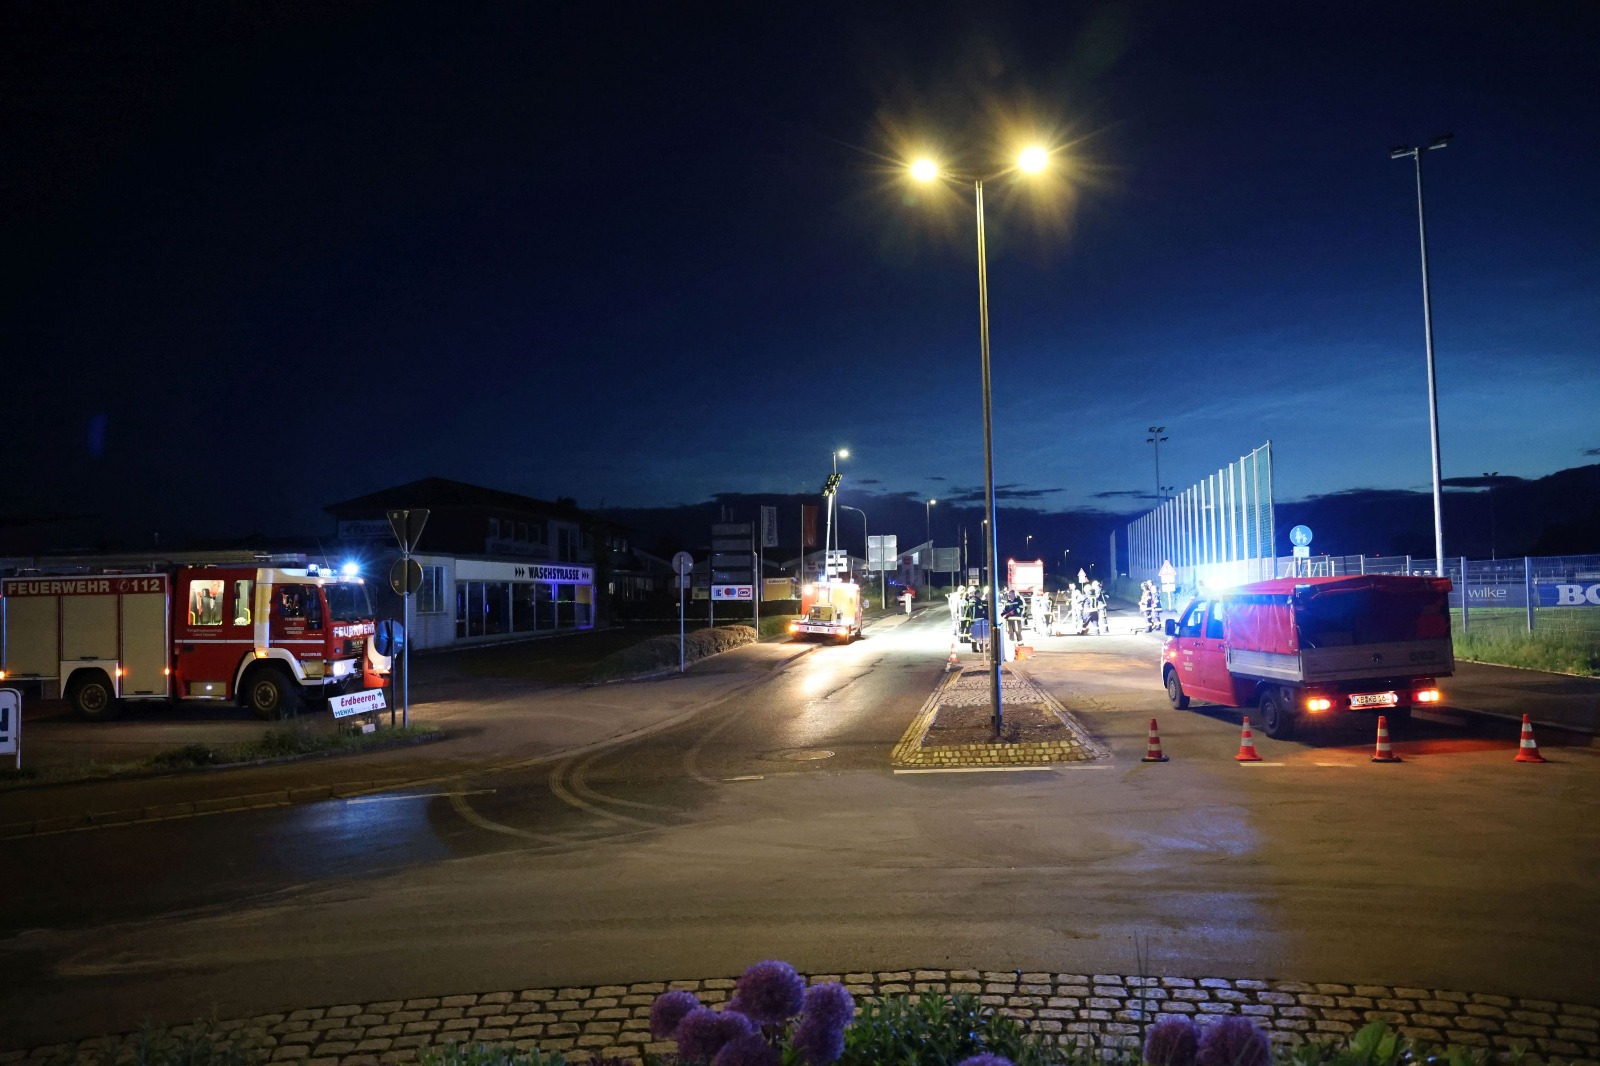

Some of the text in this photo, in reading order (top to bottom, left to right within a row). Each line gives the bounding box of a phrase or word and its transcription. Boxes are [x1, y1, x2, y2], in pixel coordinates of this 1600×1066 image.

[528, 566, 580, 581] WASCHSTRASSE
[7, 578, 160, 595] FEUERWEHR 112
[1467, 586, 1507, 598] wilke
[333, 623, 375, 638] FEUERWEHR
[340, 693, 376, 707] Erdbeeren
[334, 707, 355, 717] MENKE
